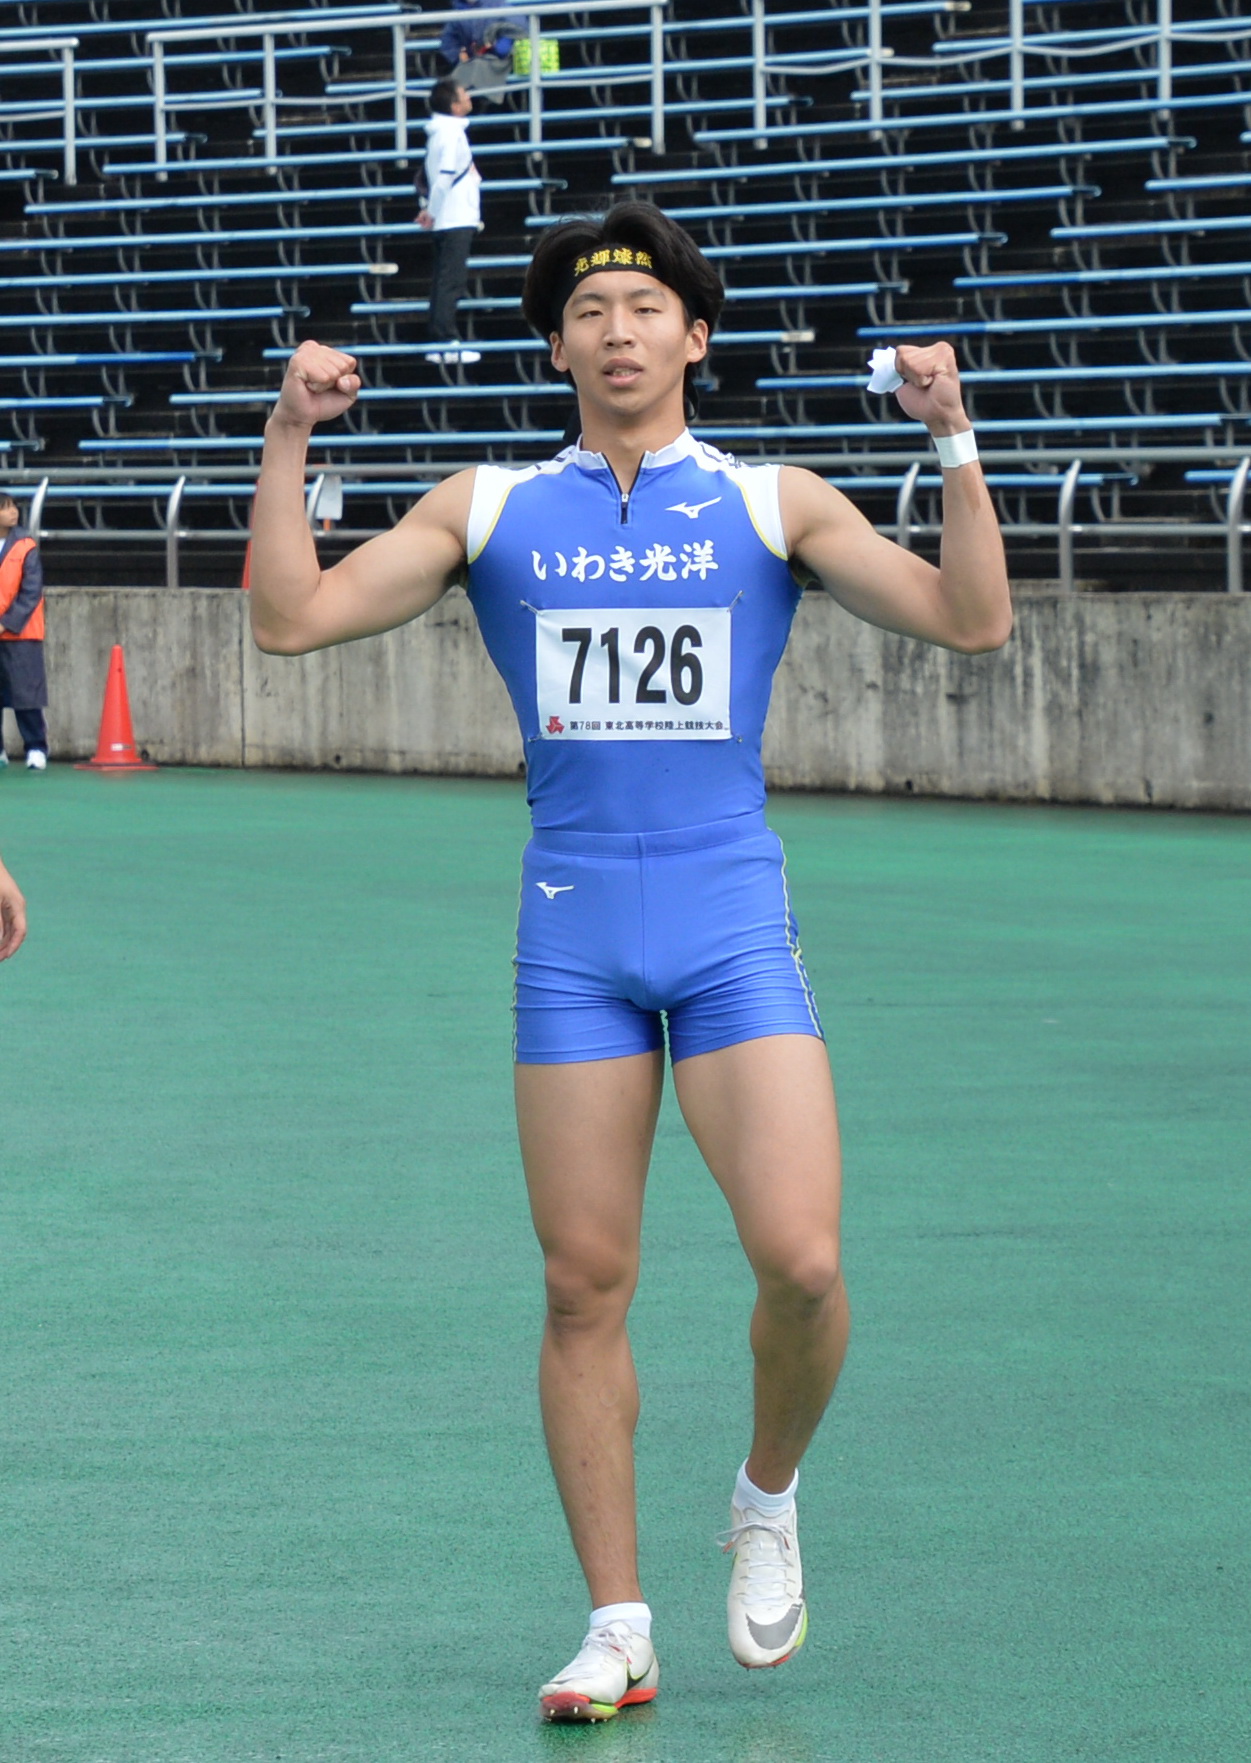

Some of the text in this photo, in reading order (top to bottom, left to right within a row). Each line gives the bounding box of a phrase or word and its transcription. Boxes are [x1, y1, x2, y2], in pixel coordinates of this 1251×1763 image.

[531, 539, 719, 583] いわき光洋
[561, 624, 703, 706] 7126
[569, 720, 601, 731] 第78回
[604, 720, 724, 731] 東北高等学校陸上競技大会
